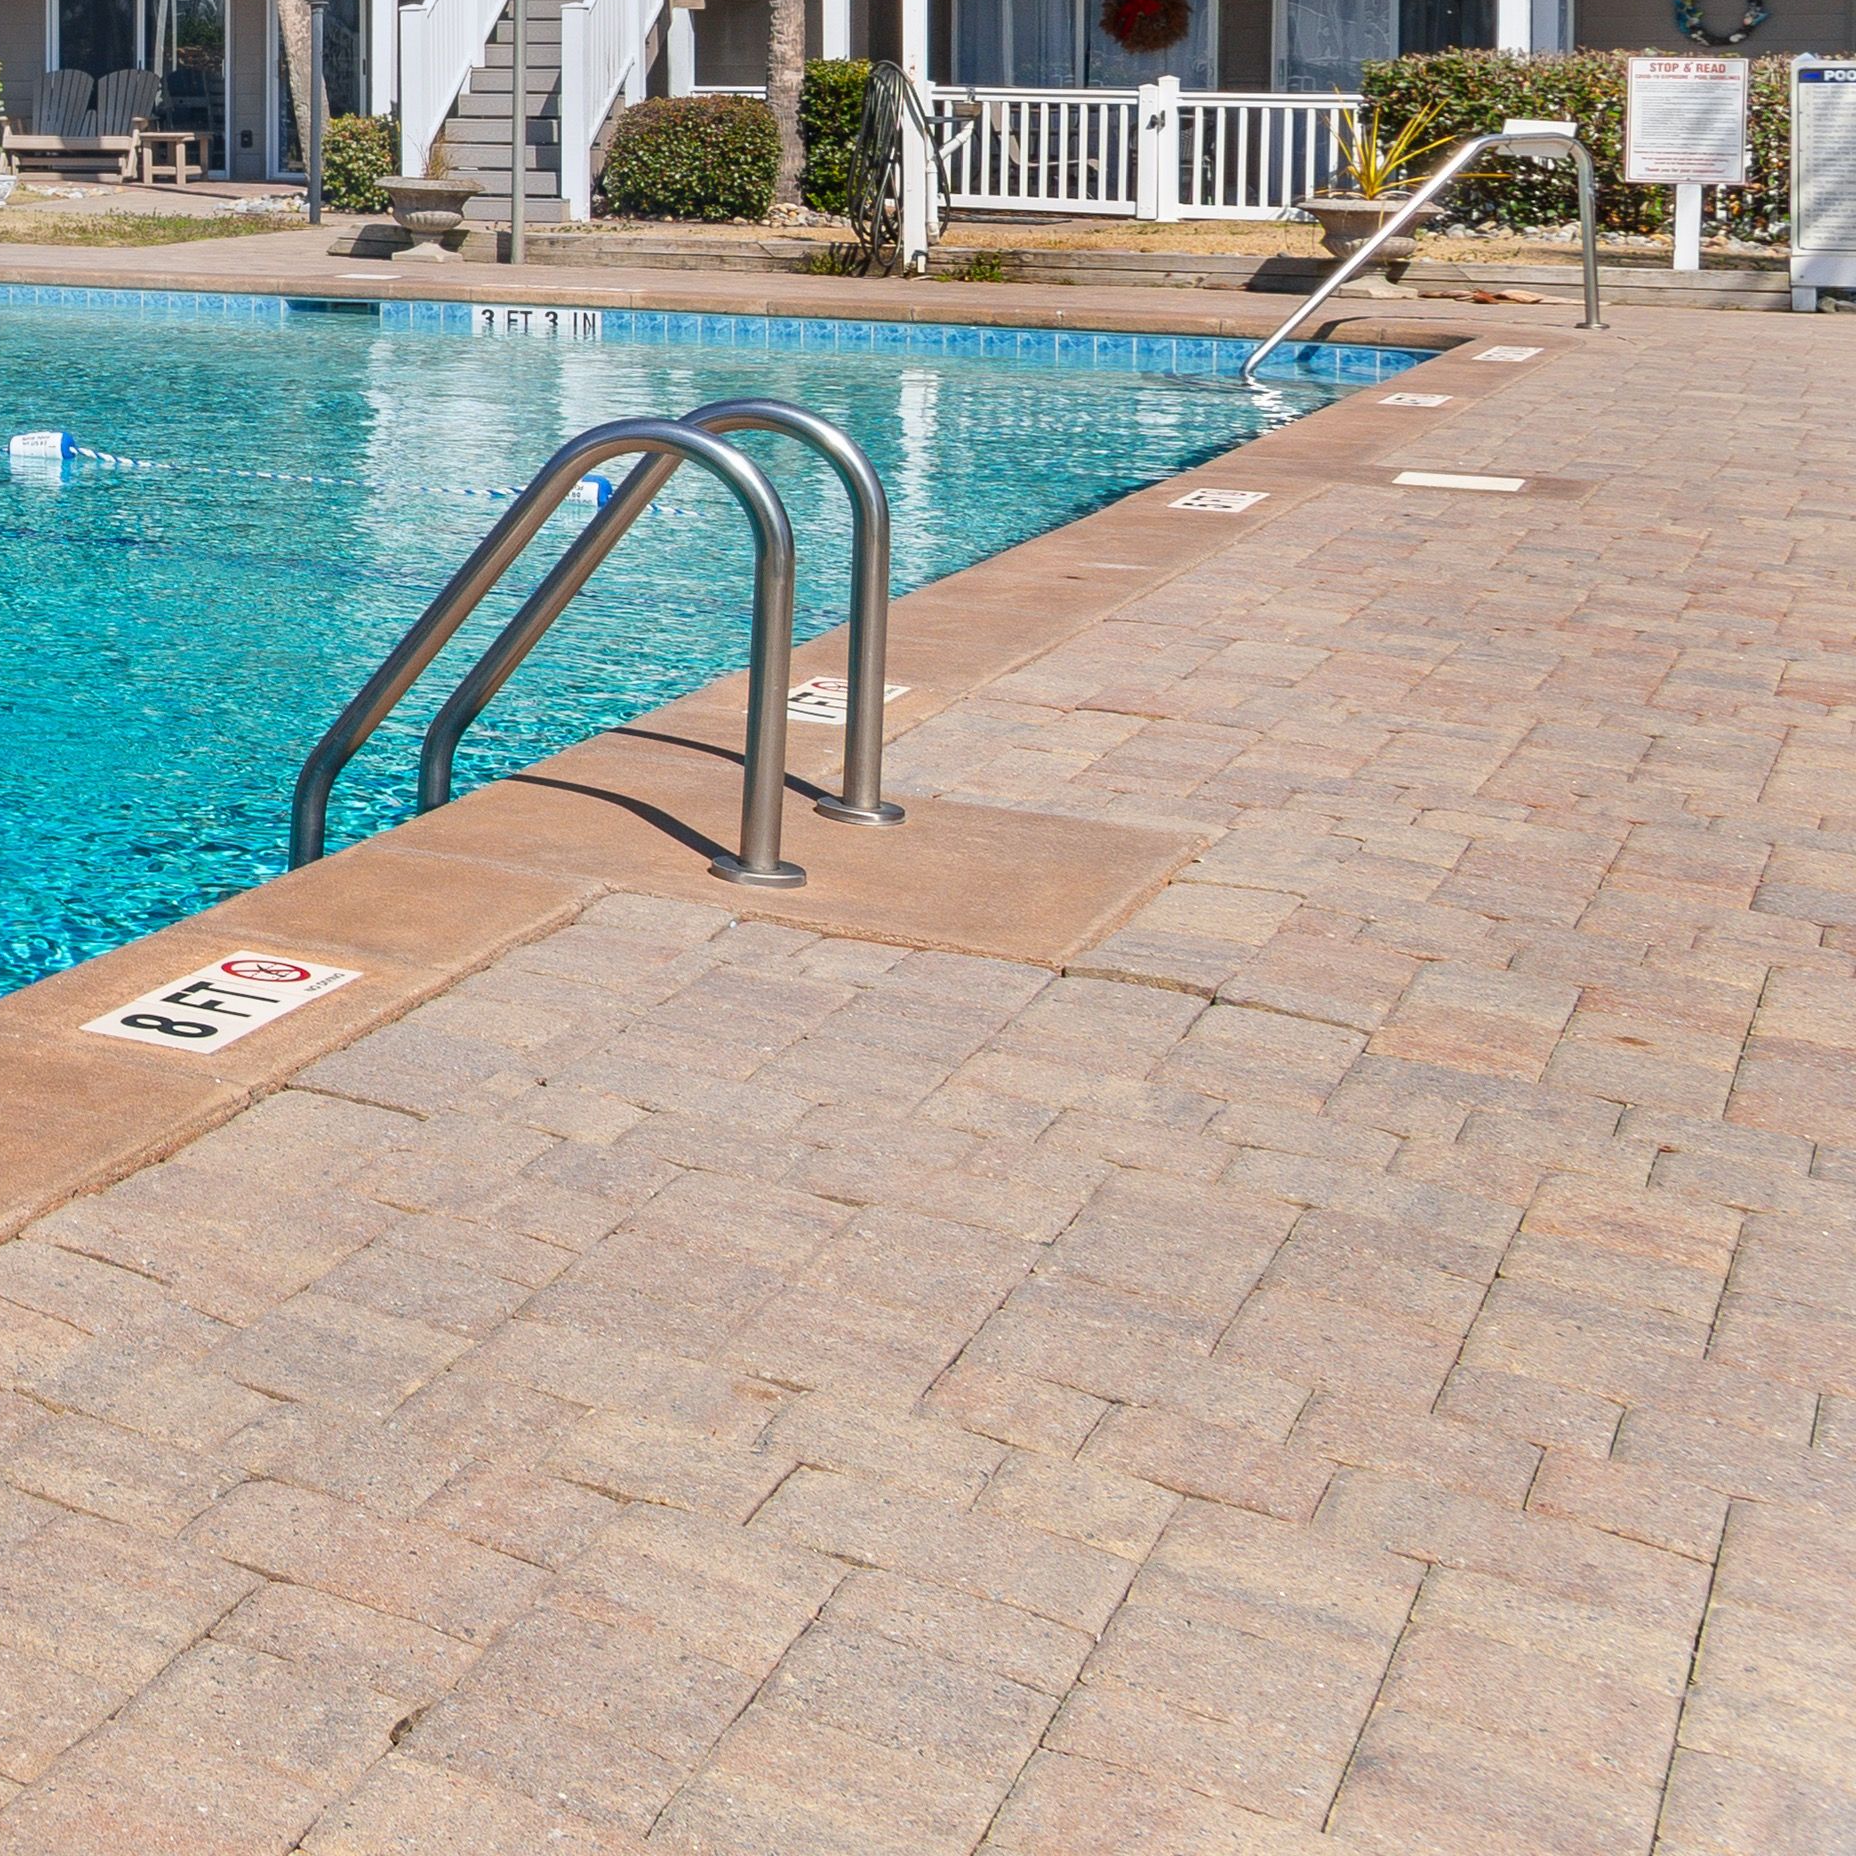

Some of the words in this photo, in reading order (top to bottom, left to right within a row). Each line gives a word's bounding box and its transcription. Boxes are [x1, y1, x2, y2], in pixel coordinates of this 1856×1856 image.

[1649, 63, 1679, 73] STOP
[1683, 64, 1691, 73] &
[1696, 63, 1726, 74] READ
[481, 309, 495, 326] 3
[507, 310, 533, 334] FT
[545, 311, 558, 328] 3
[573, 312, 596, 336] IN
[160, 980, 281, 1018] FT
[120, 1013, 219, 1039] 8
